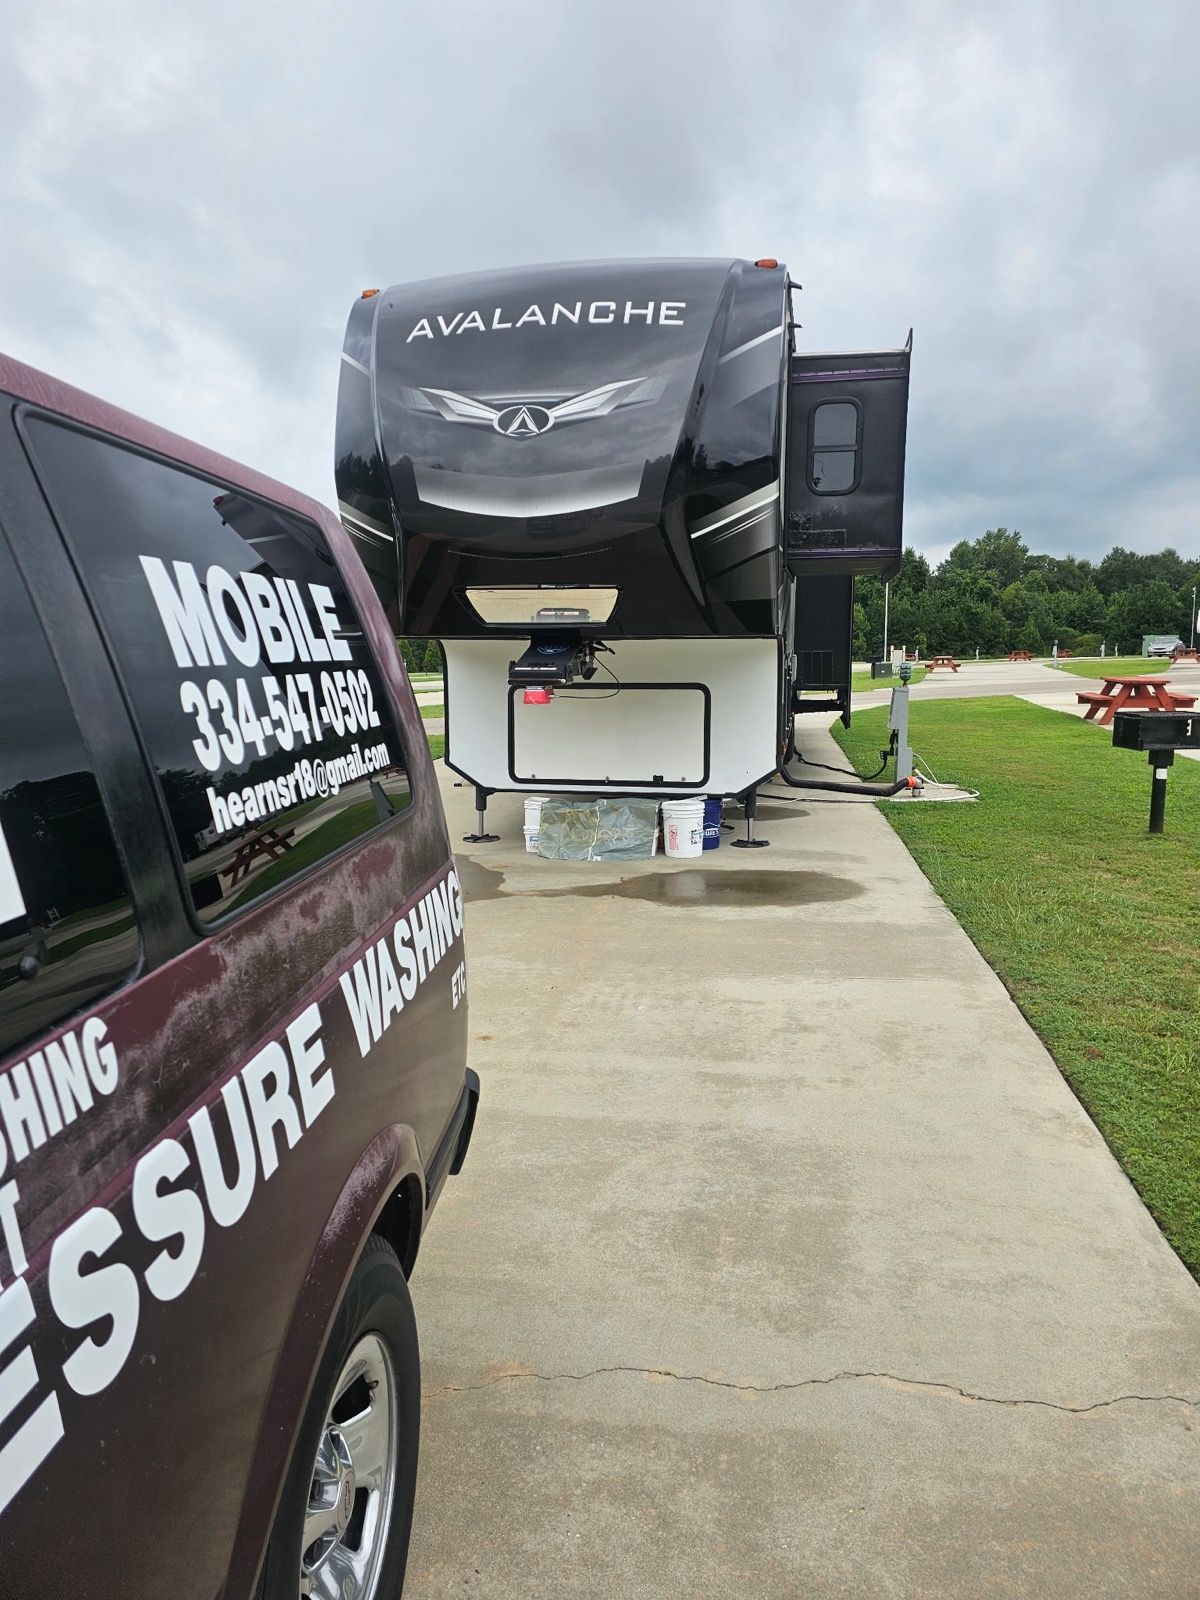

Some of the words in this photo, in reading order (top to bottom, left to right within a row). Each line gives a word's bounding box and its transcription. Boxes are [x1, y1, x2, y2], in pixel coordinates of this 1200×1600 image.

[406, 300, 687, 344] AVALANCHE
[138, 554, 353, 668] MOBILE
[180, 669, 381, 771] 334-547-0502
[206, 742, 391, 834] hearnsr18@gmail.com
[339, 870, 464, 1058] WASHING
[0, 1016, 119, 1180] HING
